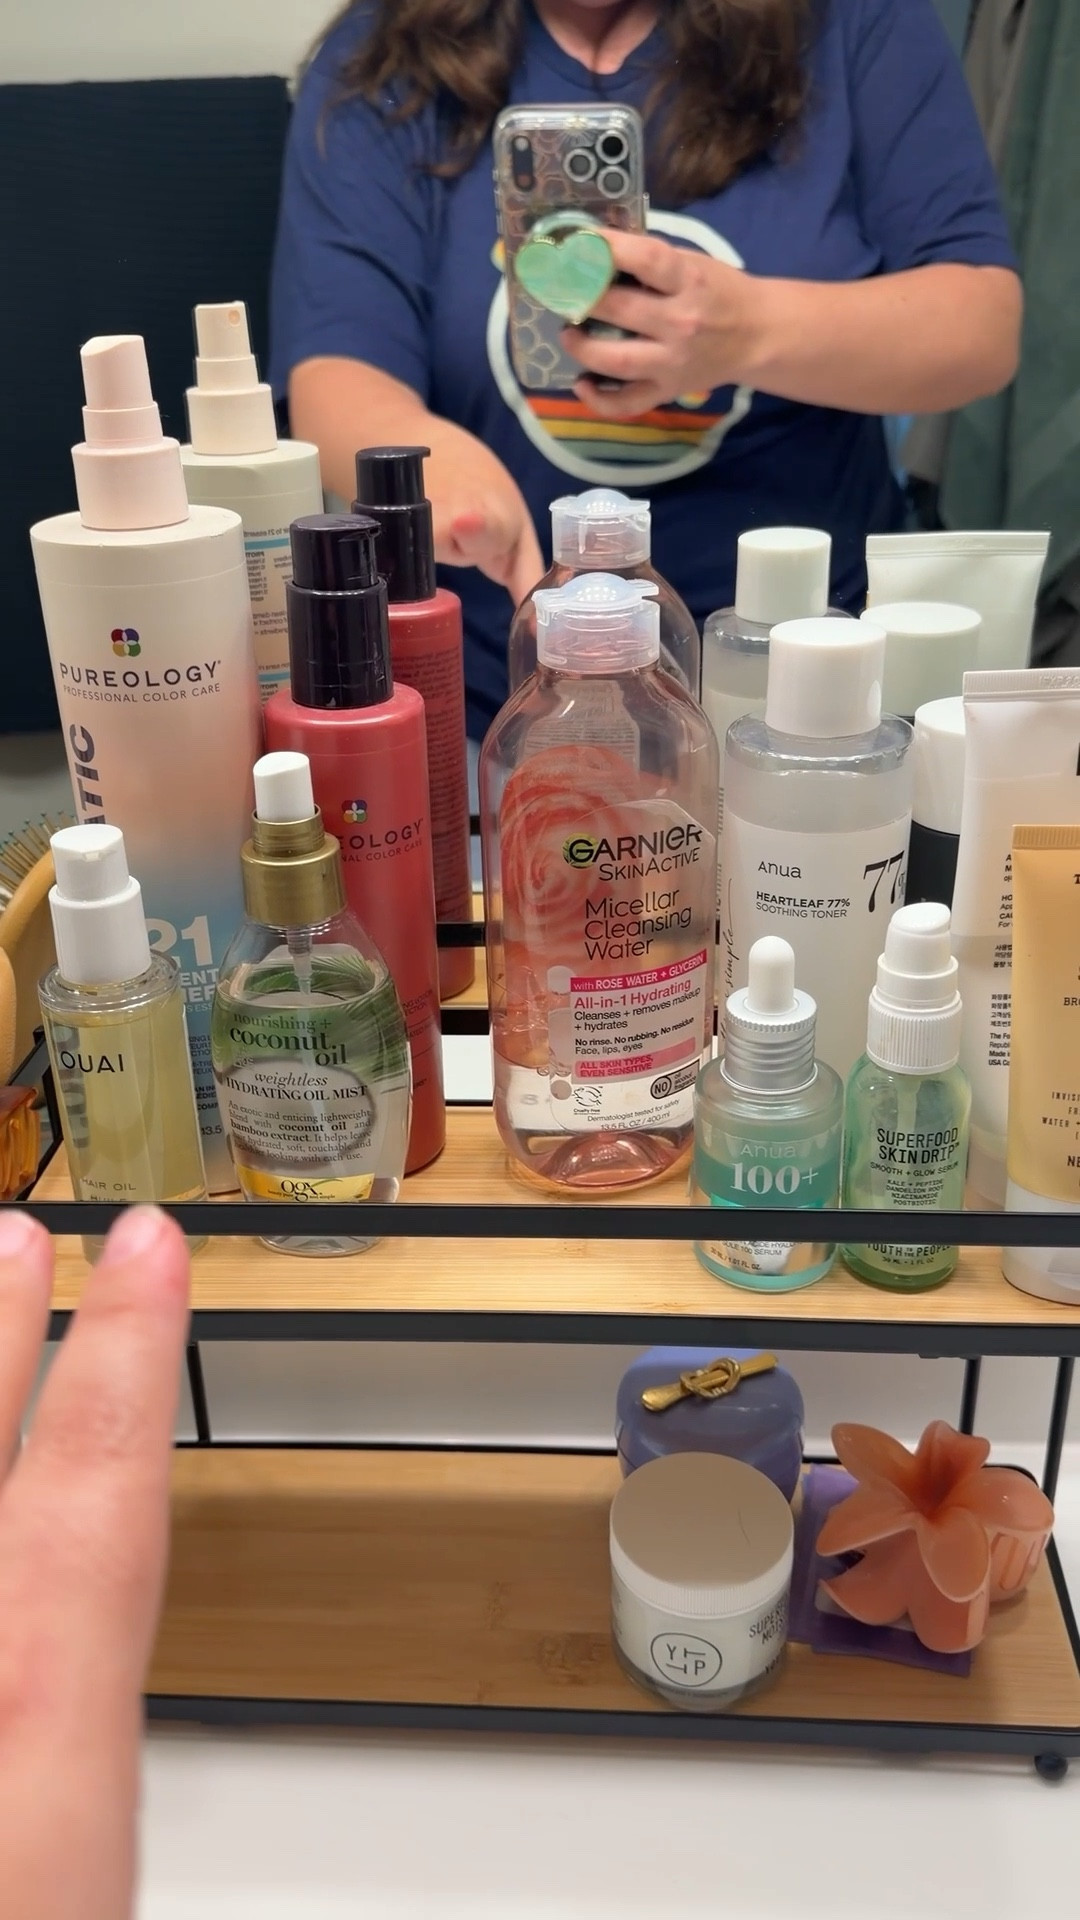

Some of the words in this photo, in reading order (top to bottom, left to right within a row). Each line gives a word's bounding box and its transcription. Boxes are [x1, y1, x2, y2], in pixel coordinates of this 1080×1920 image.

[63, 684, 138, 703] PROFESSIONAL
[143, 688, 187, 702] COLOR
[191, 683, 221, 697] CARE
[69, 724, 106, 824] TIC
[567, 824, 702, 863] GARNIER
[366, 847, 401, 861] COLOR
[757, 861, 802, 879] Anua
[586, 890, 681, 919] Micellar
[756, 891, 824, 908] HEARTLEAF
[827, 898, 850, 908] 77%
[756, 902, 808, 918] SOOTHING
[811, 909, 847, 918] TONER
[584, 907, 691, 940] Cleansing
[584, 938, 654, 961] Water
[573, 982, 595, 991] with
[596, 977, 623, 989] ROSE
[626, 972, 658, 987] WATER
[669, 954, 703, 976] GLYCERIN
[575, 996, 626, 1009] All-in-1
[631, 980, 691, 1006] Hydrating
[575, 1010, 621, 1020] Cleanses
[633, 1001, 671, 1016] removes
[672, 987, 701, 1004] makeup
[234, 1013, 316, 1033] nourishing
[575, 1038, 588, 1047] No
[589, 1038, 613, 1046] rinse.
[615, 1036, 626, 1045] No
[628, 1030, 660, 1044] rubbing.
[661, 1026, 671, 1036] No
[672, 1017, 694, 1031] residue
[584, 1020, 628, 1033] hydrates
[230, 1027, 329, 1050] coconut
[315, 1043, 348, 1067] oil
[575, 1047, 600, 1055] Face,
[602, 1046, 621, 1055] lips,
[623, 1042, 644, 1053] eyes
[61, 1051, 124, 1073] OUAI
[580, 1061, 598, 1069] ALL
[599, 1058, 622, 1068] SKIN
[580, 1068, 606, 1077] EVEN
[607, 1063, 652, 1077] SENSITIVE
[226, 1077, 301, 1101] HYDRATING
[303, 1090, 329, 1100] OIL
[332, 1085, 368, 1100] MIST
[254, 1072, 328, 1090] weightless
[654, 1081, 668, 1094] NO
[228, 1101, 239, 1111] An
[240, 1106, 262, 1117] exotic
[264, 1111, 280, 1120] and
[282, 1113, 318, 1124] enticing
[320, 1109, 371, 1122] lightweight
[229, 1109, 249, 1123] blend
[254, 1118, 272, 1128] with
[278, 1122, 324, 1132] coconut
[331, 1121, 347, 1131] oil
[354, 1120, 371, 1129] and
[587, 1112, 634, 1122] Dermatologist
[634, 1108, 654, 1117] tested
[1042, 1116, 1069, 1127] WATER
[230, 1118, 269, 1139] bamboo
[270, 1131, 310, 1142] extract.
[314, 1133, 322, 1142] It
[324, 1132, 348, 1143] helps
[877, 1127, 959, 1149] SUPERFOOD
[247, 1135, 285, 1151] hydrated,
[286, 1142, 306, 1153] soft,
[308, 1142, 352, 1153] touchable
[355, 1139, 372, 1149] and
[740, 1143, 797, 1159] Anua
[267, 1149, 300, 1162] looking
[301, 1154, 321, 1162] with
[323, 1152, 343, 1161] each
[879, 1145, 917, 1164] SKIN
[728, 1162, 819, 1195] 100+
[870, 1162, 903, 1176] SMOOTH
[913, 1168, 936, 1177] GLOW
[937, 1162, 959, 1175] SERUM
[81, 1178, 107, 1191] HAIR
[112, 1182, 136, 1191] OIL
[886, 1185, 927, 1194] DANDELION
[887, 1179, 905, 1187] KALE
[915, 1178, 943, 1187] PEPTIDE
[891, 1192, 939, 1200] NIACINAMIDE
[893, 1199, 936, 1207] POSTBIOTIC
[754, 1248, 782, 1256] SERUM
